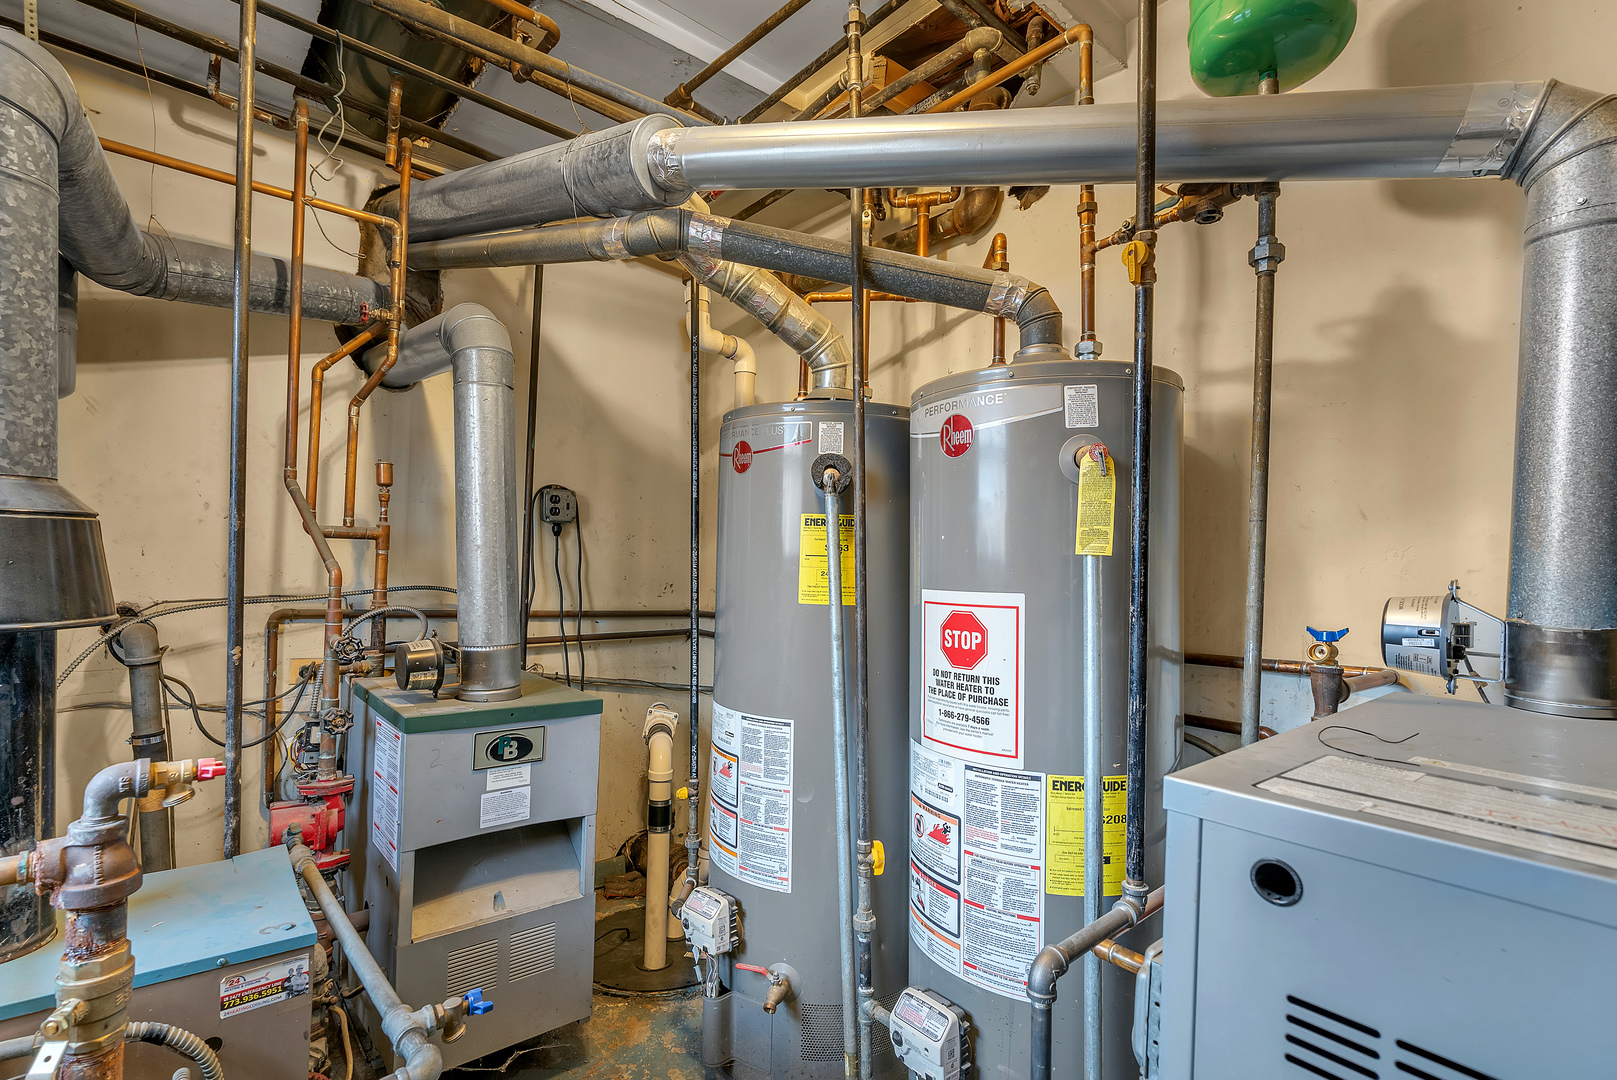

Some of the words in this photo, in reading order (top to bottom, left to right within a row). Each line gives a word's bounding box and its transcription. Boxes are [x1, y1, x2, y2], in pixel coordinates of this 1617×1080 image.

[925, 394, 1003, 418] PERFORMANCE
[942, 416, 972, 452] Rheem
[944, 629, 982, 650] STOP
[933, 668, 939, 677] DO
[941, 670, 952, 679] NOT
[954, 672, 980, 684] RETURN
[982, 676, 1000, 686] THIS
[936, 679, 954, 689] WATER
[956, 683, 982, 693] HEATER
[985, 687, 995, 695] TO
[928, 686, 937, 695] THE
[938, 688, 956, 700] PLACE
[958, 692, 966, 700] OF
[968, 694, 1008, 707] PURCHASE
[939, 709, 990, 725] 1-866-279-4566
[498, 737, 518, 759] PB
[430, 749, 442, 768] 2
[229, 977, 240, 986] 24
[241, 985, 271, 996] EMERGENCY
[224, 986, 282, 1009] 773.936.5951
[224, 996, 282, 1016] 24HEATINGCOOLING.COM
